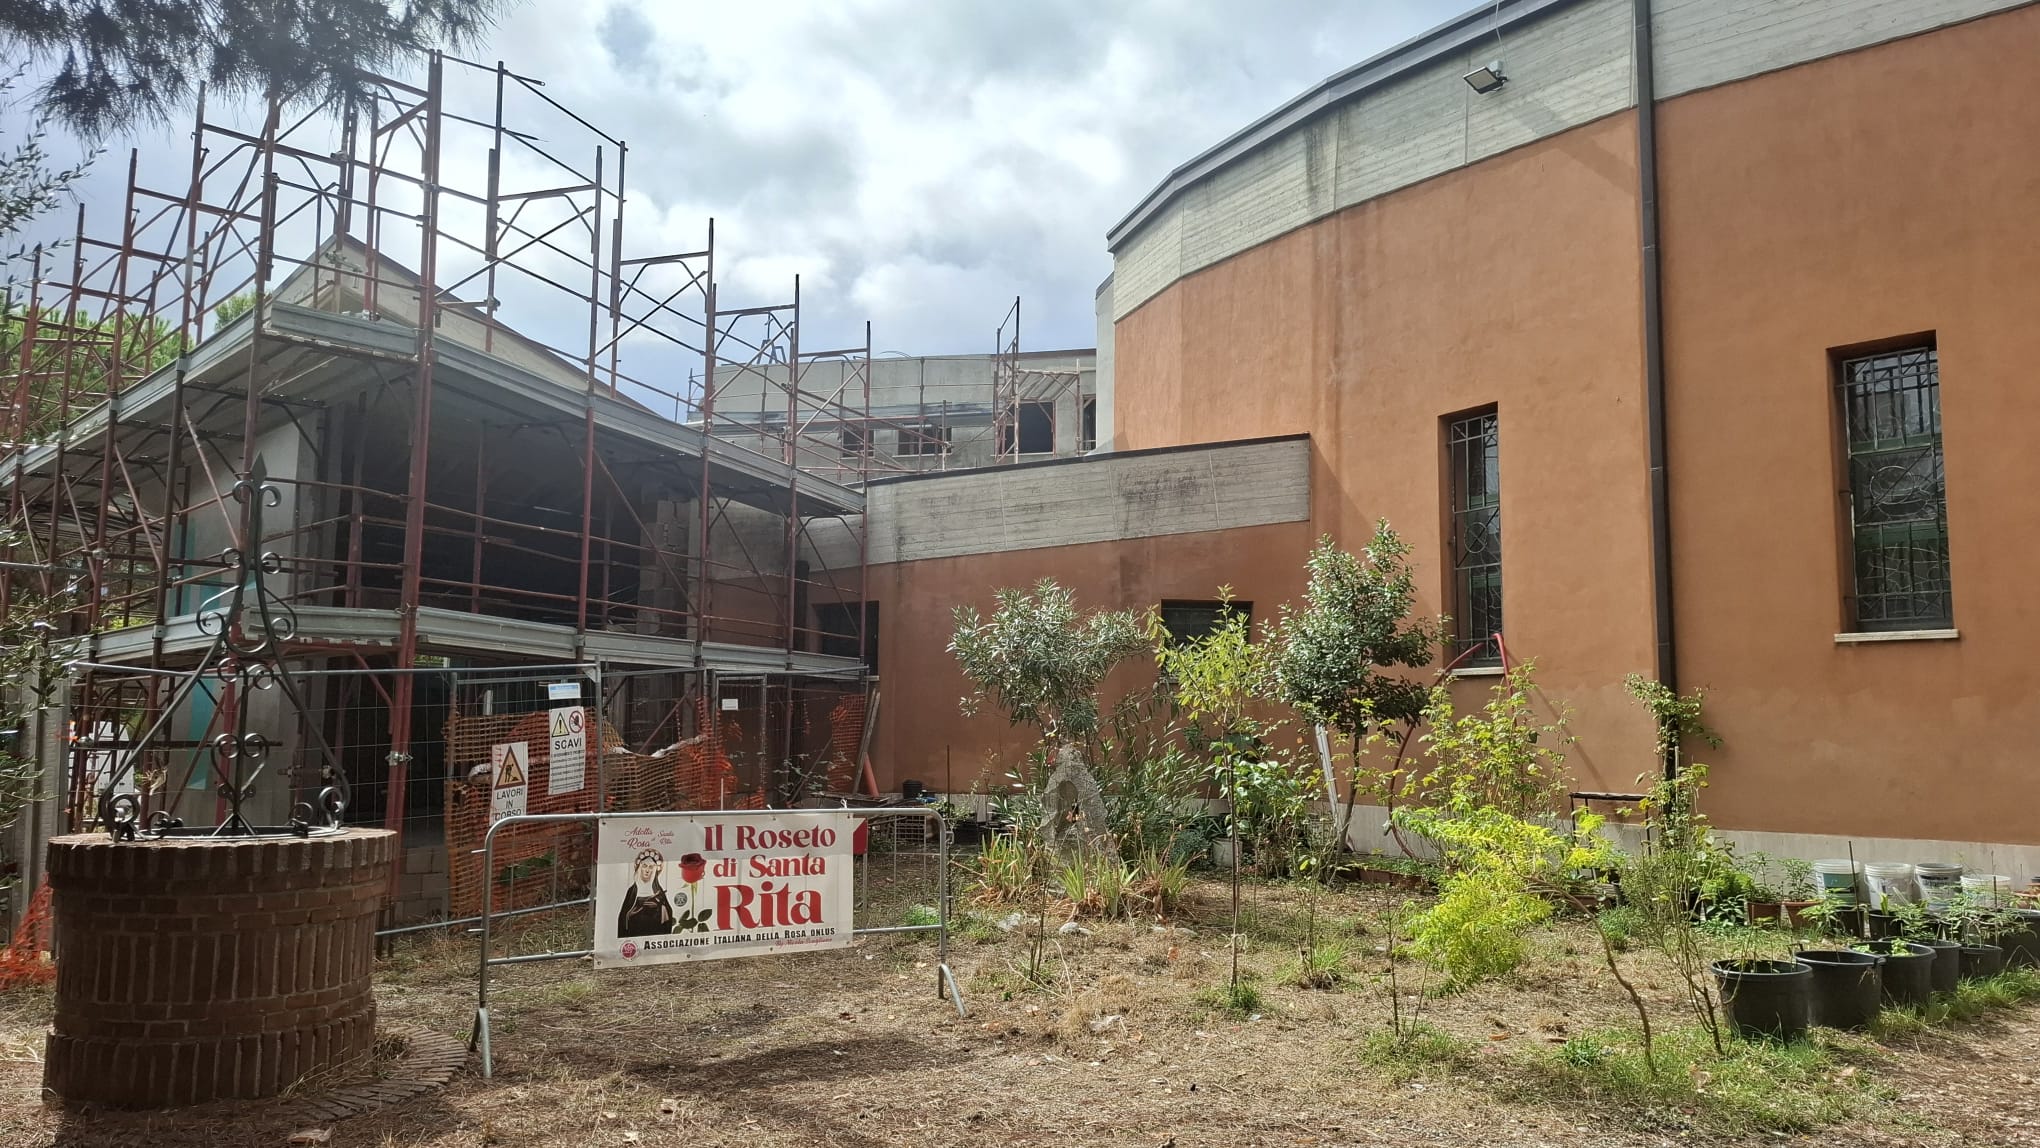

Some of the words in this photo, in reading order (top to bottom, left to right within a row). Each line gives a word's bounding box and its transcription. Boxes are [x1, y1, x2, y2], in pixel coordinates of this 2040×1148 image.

[554, 737, 582, 750] SCAVI
[496, 788, 523, 800] LAVORI
[505, 799, 514, 809] IN
[626, 837, 650, 850] Rosa
[703, 824, 724, 851] Il
[736, 824, 836, 851] Roseto
[713, 857, 737, 877] di
[749, 853, 826, 878] Santa
[712, 880, 825, 932] Rita
[643, 937, 710, 950] ASSOCIAZIONE
[714, 934, 752, 945] ITALIANA
[756, 931, 780, 941] DELLA
[784, 929, 807, 939] ROSA
[810, 927, 836, 937] ONLUS
